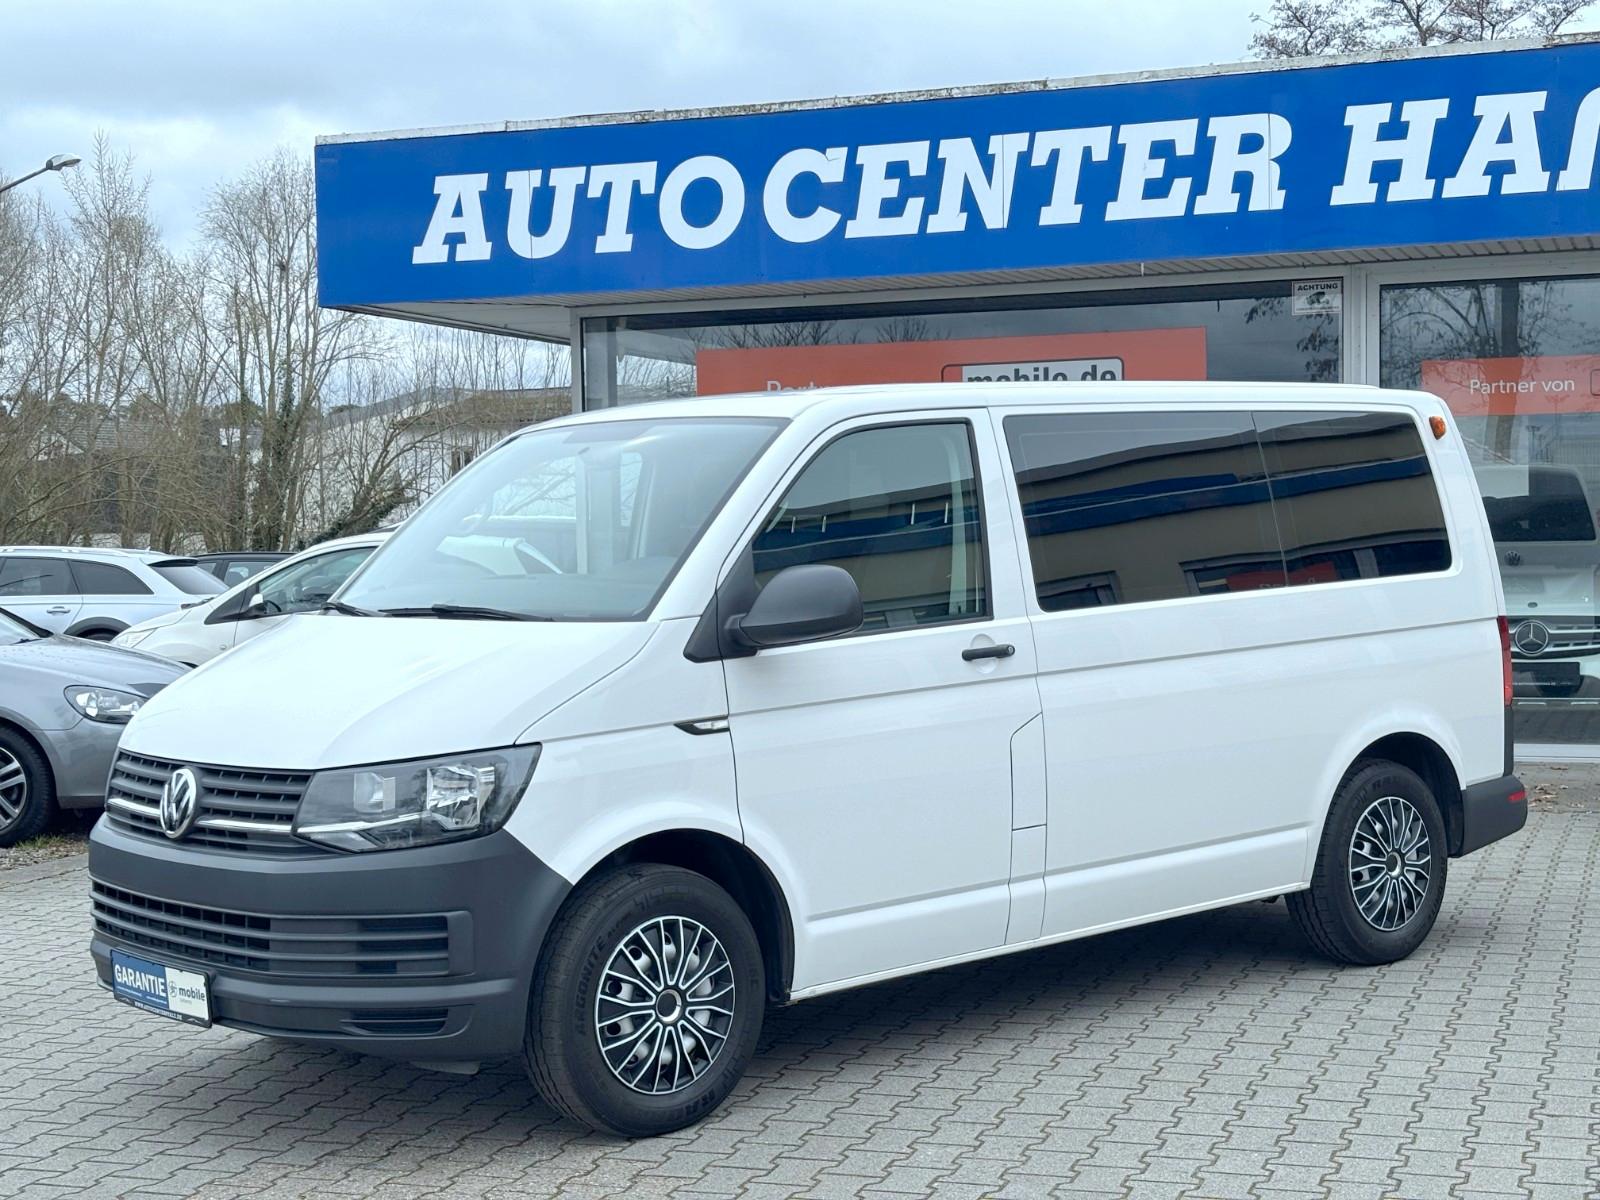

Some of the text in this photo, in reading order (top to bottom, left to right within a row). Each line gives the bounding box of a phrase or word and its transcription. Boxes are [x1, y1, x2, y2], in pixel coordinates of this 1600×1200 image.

[1297, 283, 1338, 291] ACHTUNG
[1470, 379, 1575, 395] Partner von
[114, 964, 167, 998] GARANTIE
[178, 985, 206, 1002] mobile
